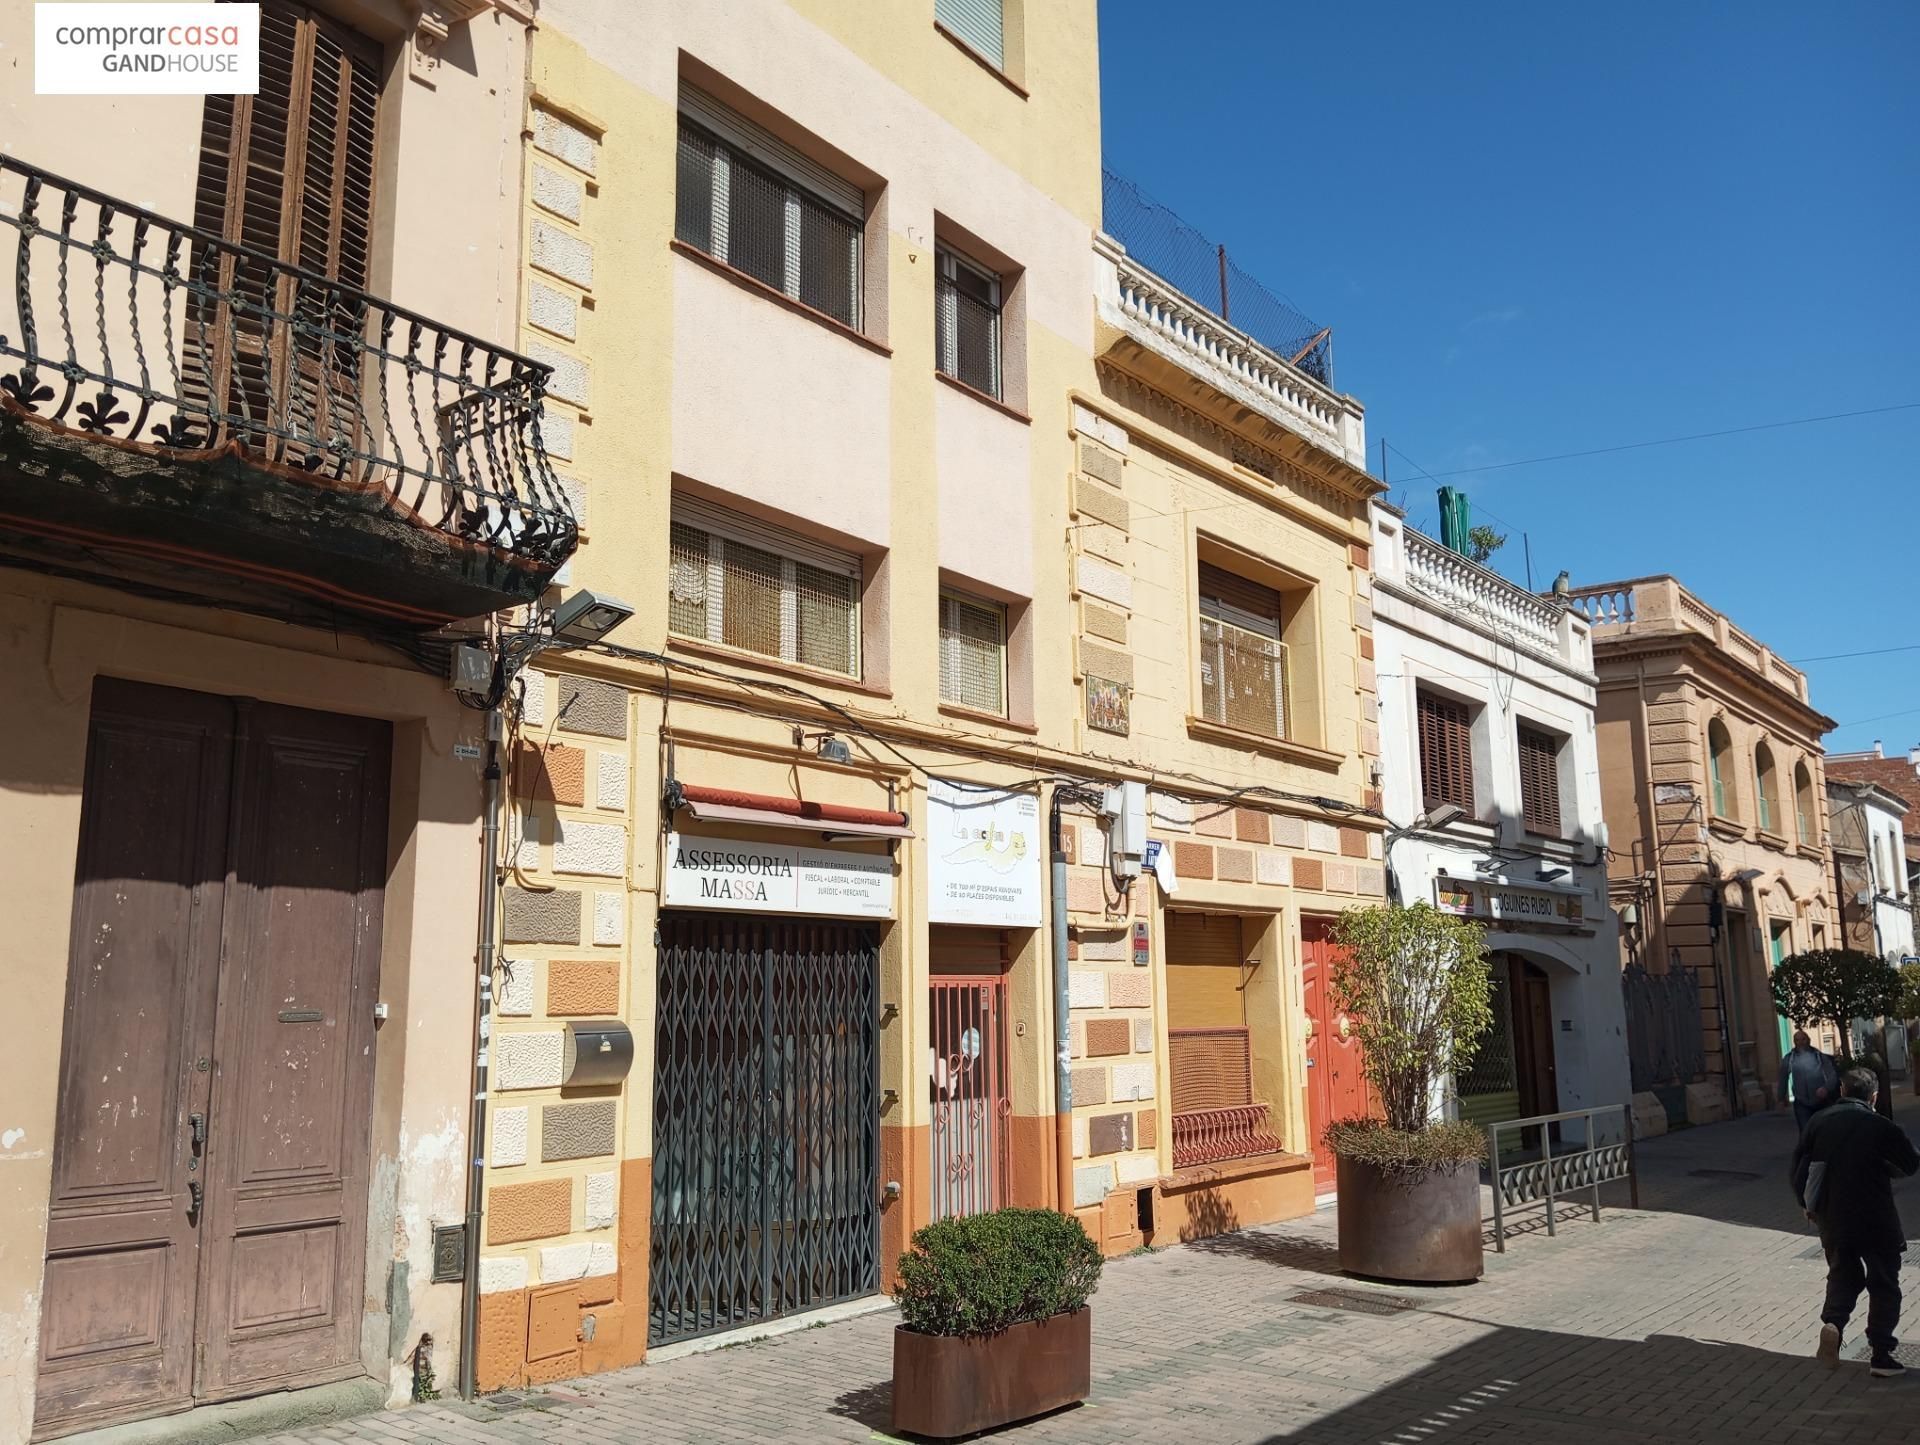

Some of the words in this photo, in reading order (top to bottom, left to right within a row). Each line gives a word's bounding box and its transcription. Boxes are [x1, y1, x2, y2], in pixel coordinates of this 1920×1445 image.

[672, 847, 792, 878] ASSESSORIA
[700, 877, 768, 902] MASSA
[805, 874, 824, 882] FISCAL
[828, 876, 850, 884] LABORAL
[854, 878, 881, 886] COMPTABLE
[842, 888, 870, 898] MERCANTIL
[1494, 892, 1530, 915] JOGUINES
